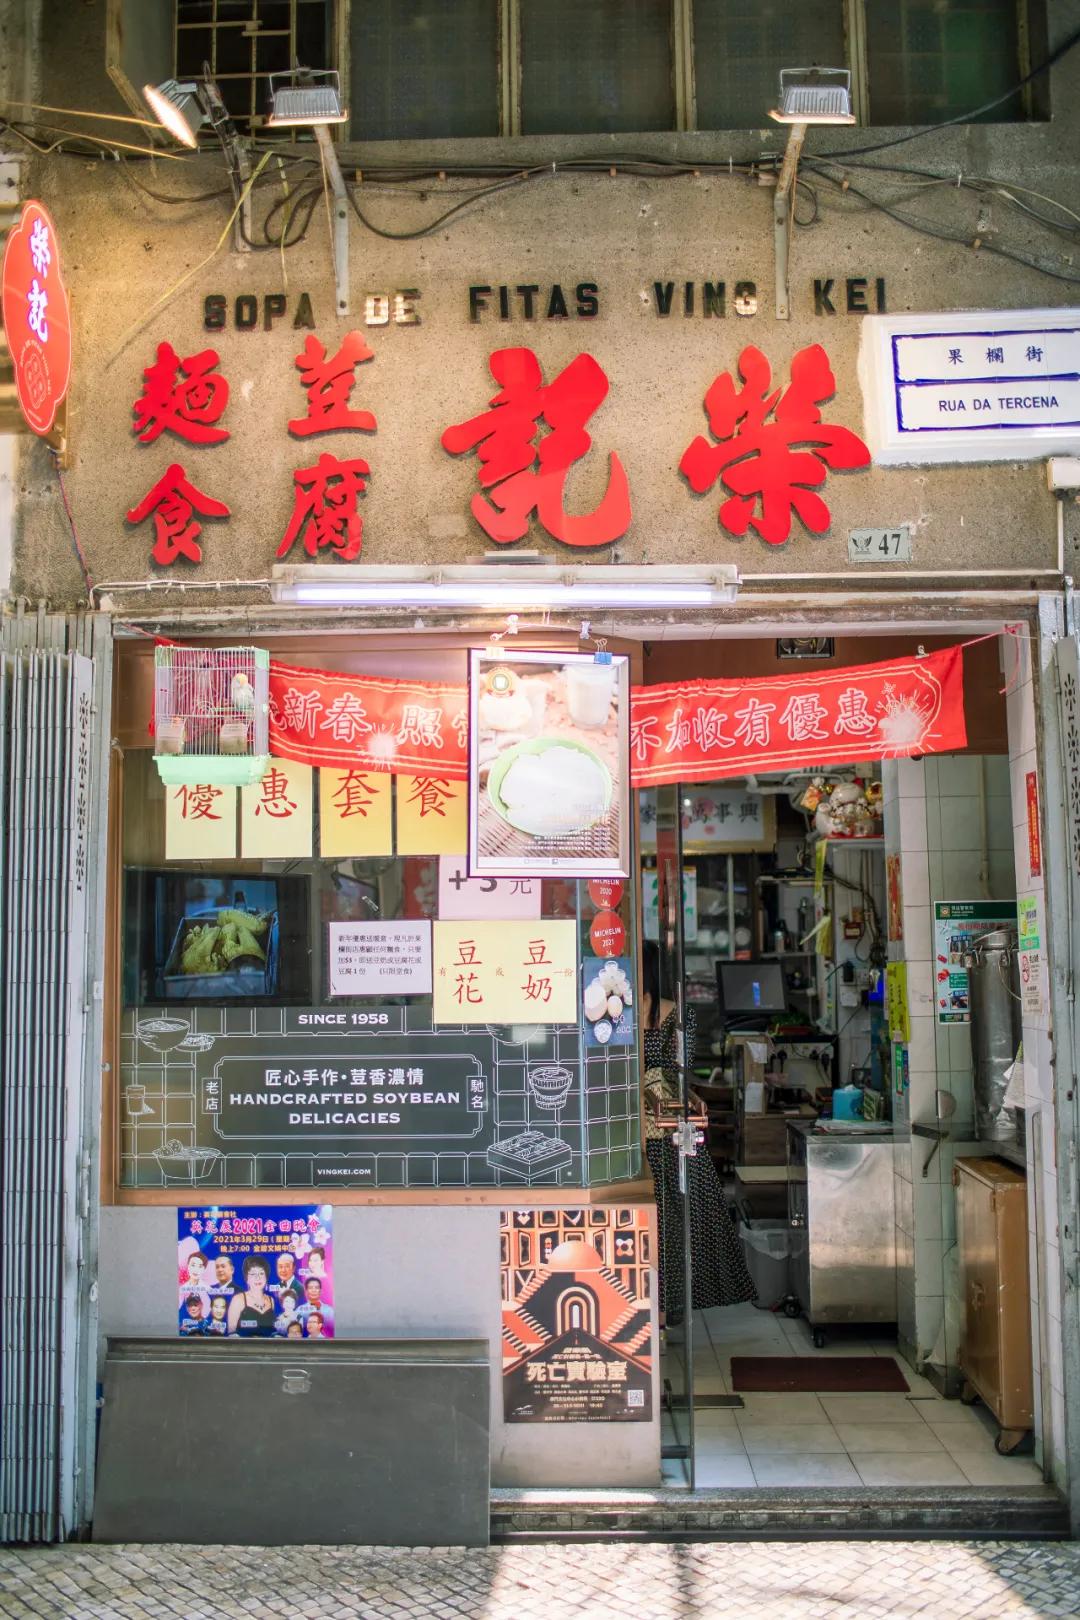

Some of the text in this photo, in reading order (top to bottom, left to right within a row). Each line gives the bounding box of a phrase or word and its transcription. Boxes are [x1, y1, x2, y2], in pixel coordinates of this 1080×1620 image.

[204, 278, 886, 330] SOPA DE FITAS VING KEI
[949, 346, 1043, 365] 果欄街
[939, 396, 1059, 412] RUA DA TERCENA
[879, 534, 901, 555] 47
[594, 927, 621, 938] MICHELIN
[602, 939, 614, 947] 2021
[452, 940, 484, 1004] 豆花
[521, 940, 552, 1002] 豆奶
[298, 1013, 389, 1025] SINCE 1958
[205, 1081, 219, 1111] 老店
[230, 1092, 460, 1105] HANDCRAFTED SOYBEAN
[470, 1079, 484, 1109] 馳名
[289, 1113, 401, 1124] DELICACIES
[317, 1168, 371, 1176] VINGKEI.COM
